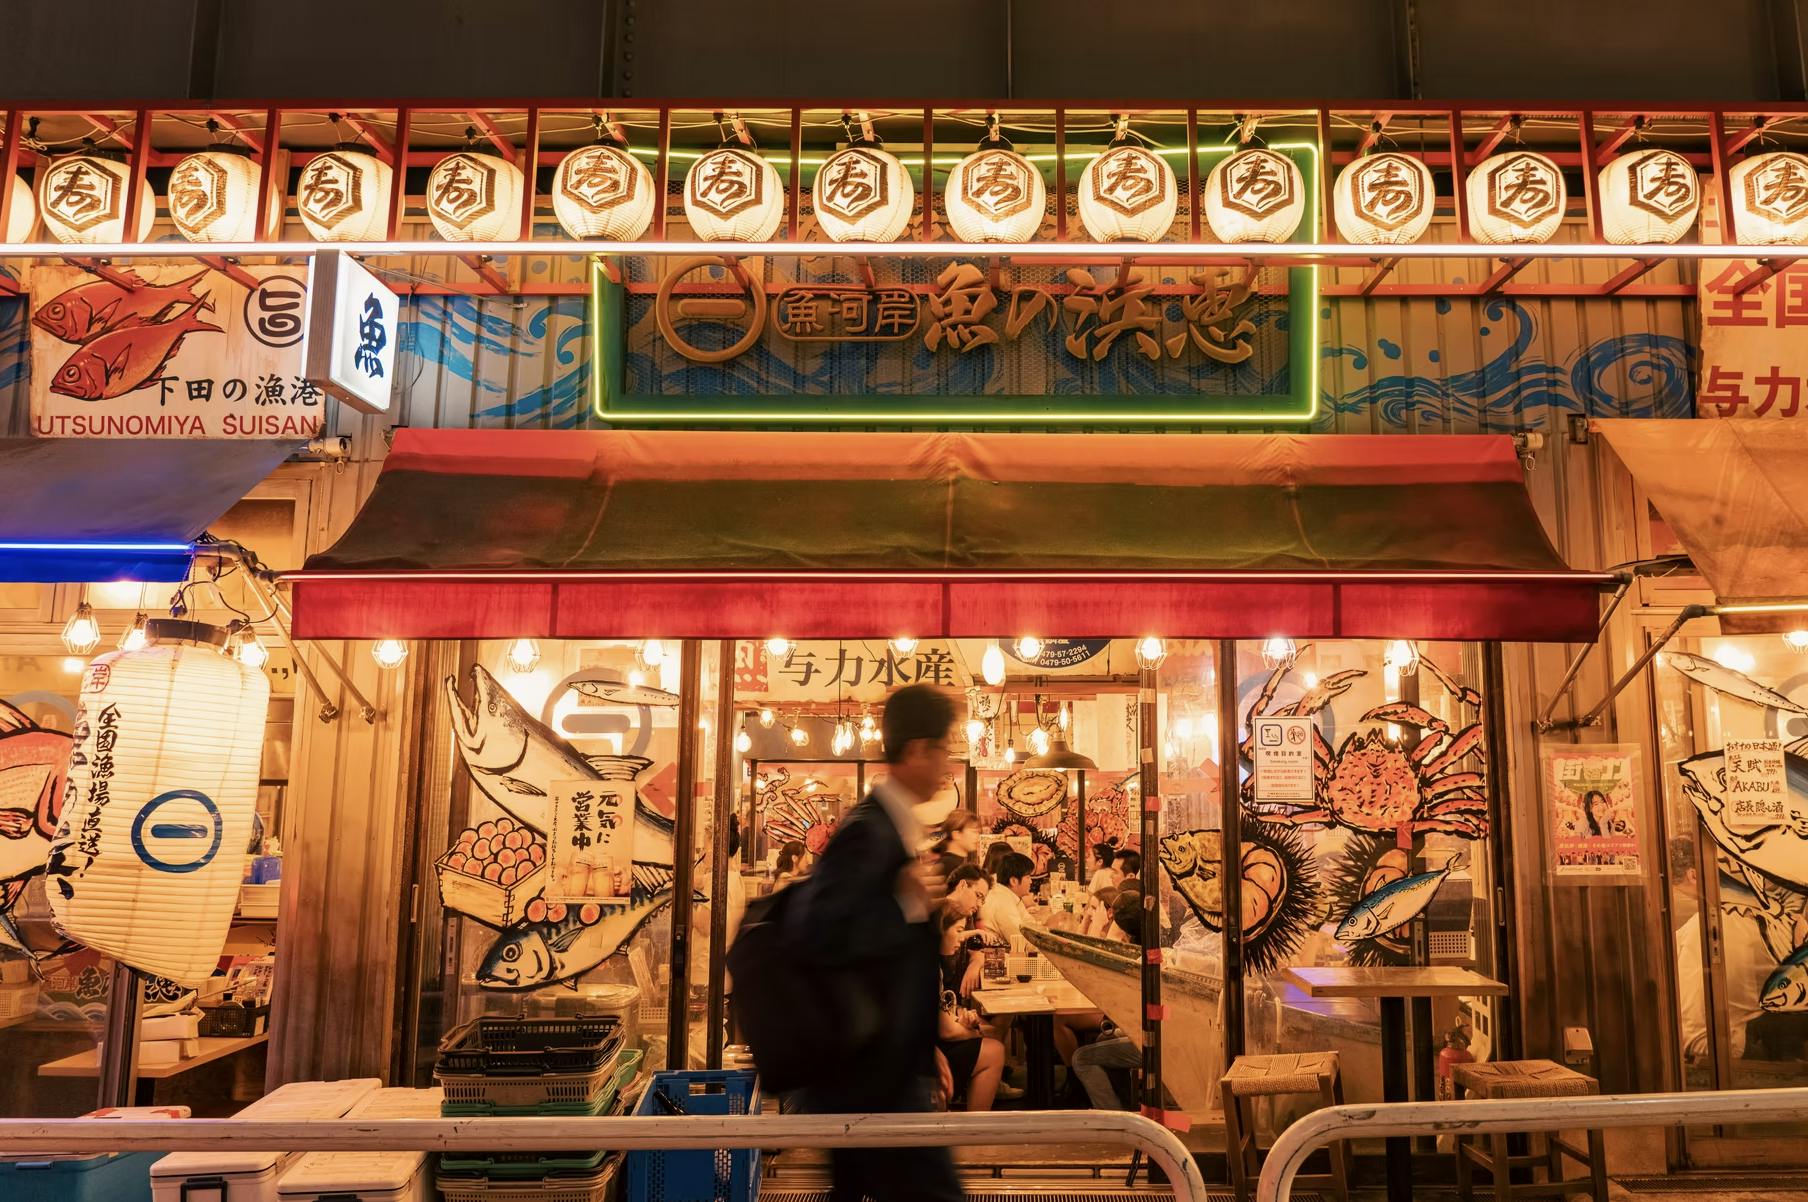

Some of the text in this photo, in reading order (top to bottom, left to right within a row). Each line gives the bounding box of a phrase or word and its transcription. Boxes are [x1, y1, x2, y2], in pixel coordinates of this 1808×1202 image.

[783, 290, 916, 333] 魚河岸
[1705, 259, 1808, 328] 全国
[354, 292, 387, 378] 魚
[156, 373, 323, 406] 下田の漁港
[1700, 365, 1808, 417] 与力
[37, 415, 317, 435] UTSUNOMIYA SUISAN
[778, 648, 955, 687] 与力水産
[1038, 644, 1087, 658] 479-57-2294
[1732, 781, 1770, 793] AKABU
[571, 790, 595, 851] 営業中
[597, 790, 619, 844] 元気に
